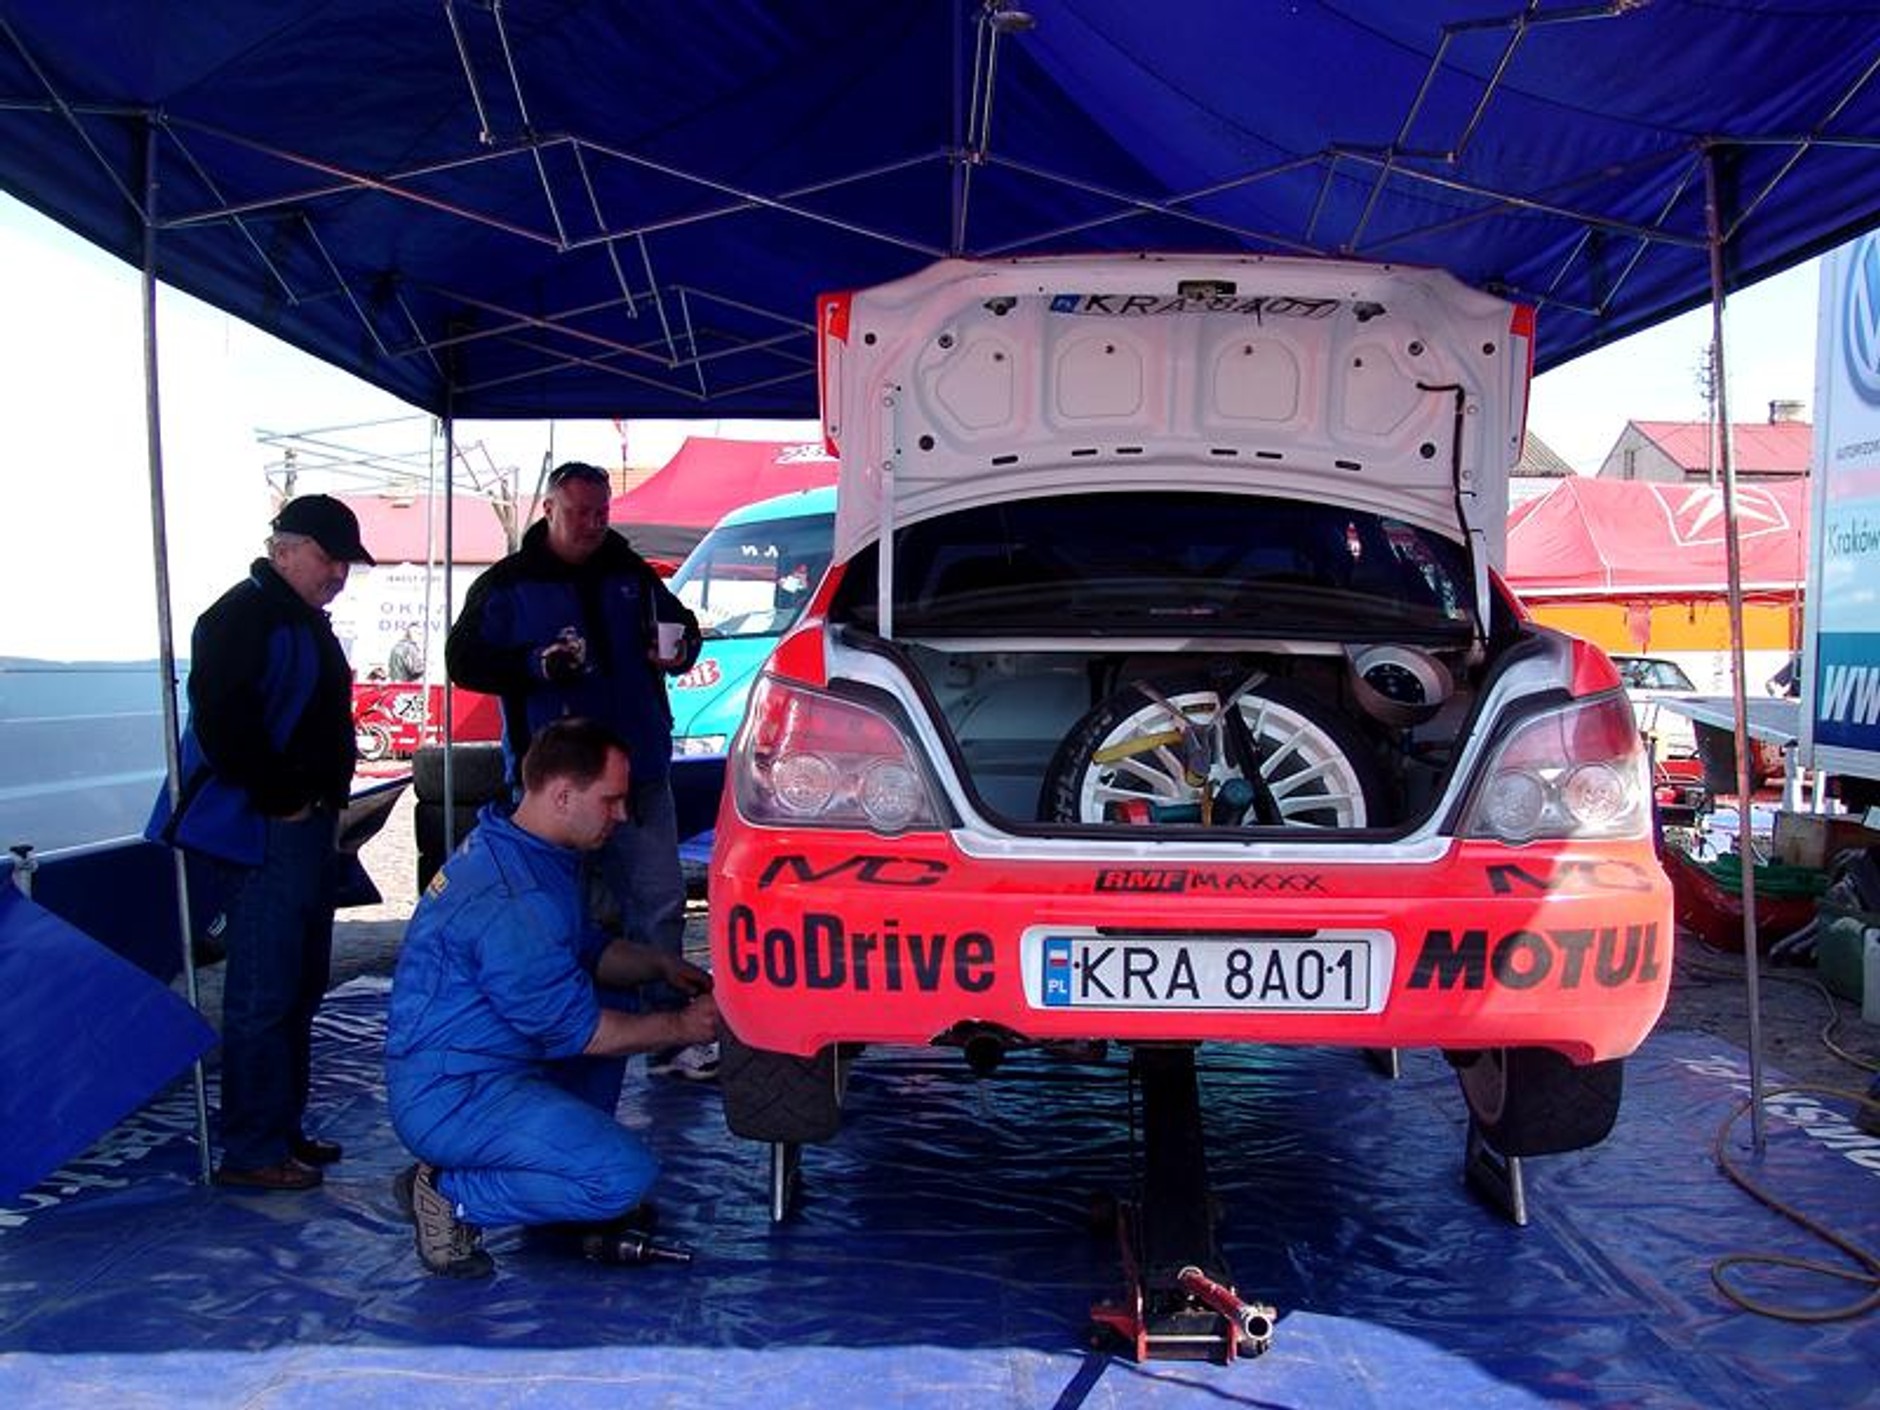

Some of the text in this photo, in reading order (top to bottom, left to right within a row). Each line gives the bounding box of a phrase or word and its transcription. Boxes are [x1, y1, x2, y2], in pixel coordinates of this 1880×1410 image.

[1098, 869, 1328, 893] RMF MAXXX
[728, 903, 995, 993] CoDrive
[1080, 946, 1353, 1001] KRA 8A01
[1406, 922, 1660, 990] MOTUL
[1047, 980, 1067, 994] PL
